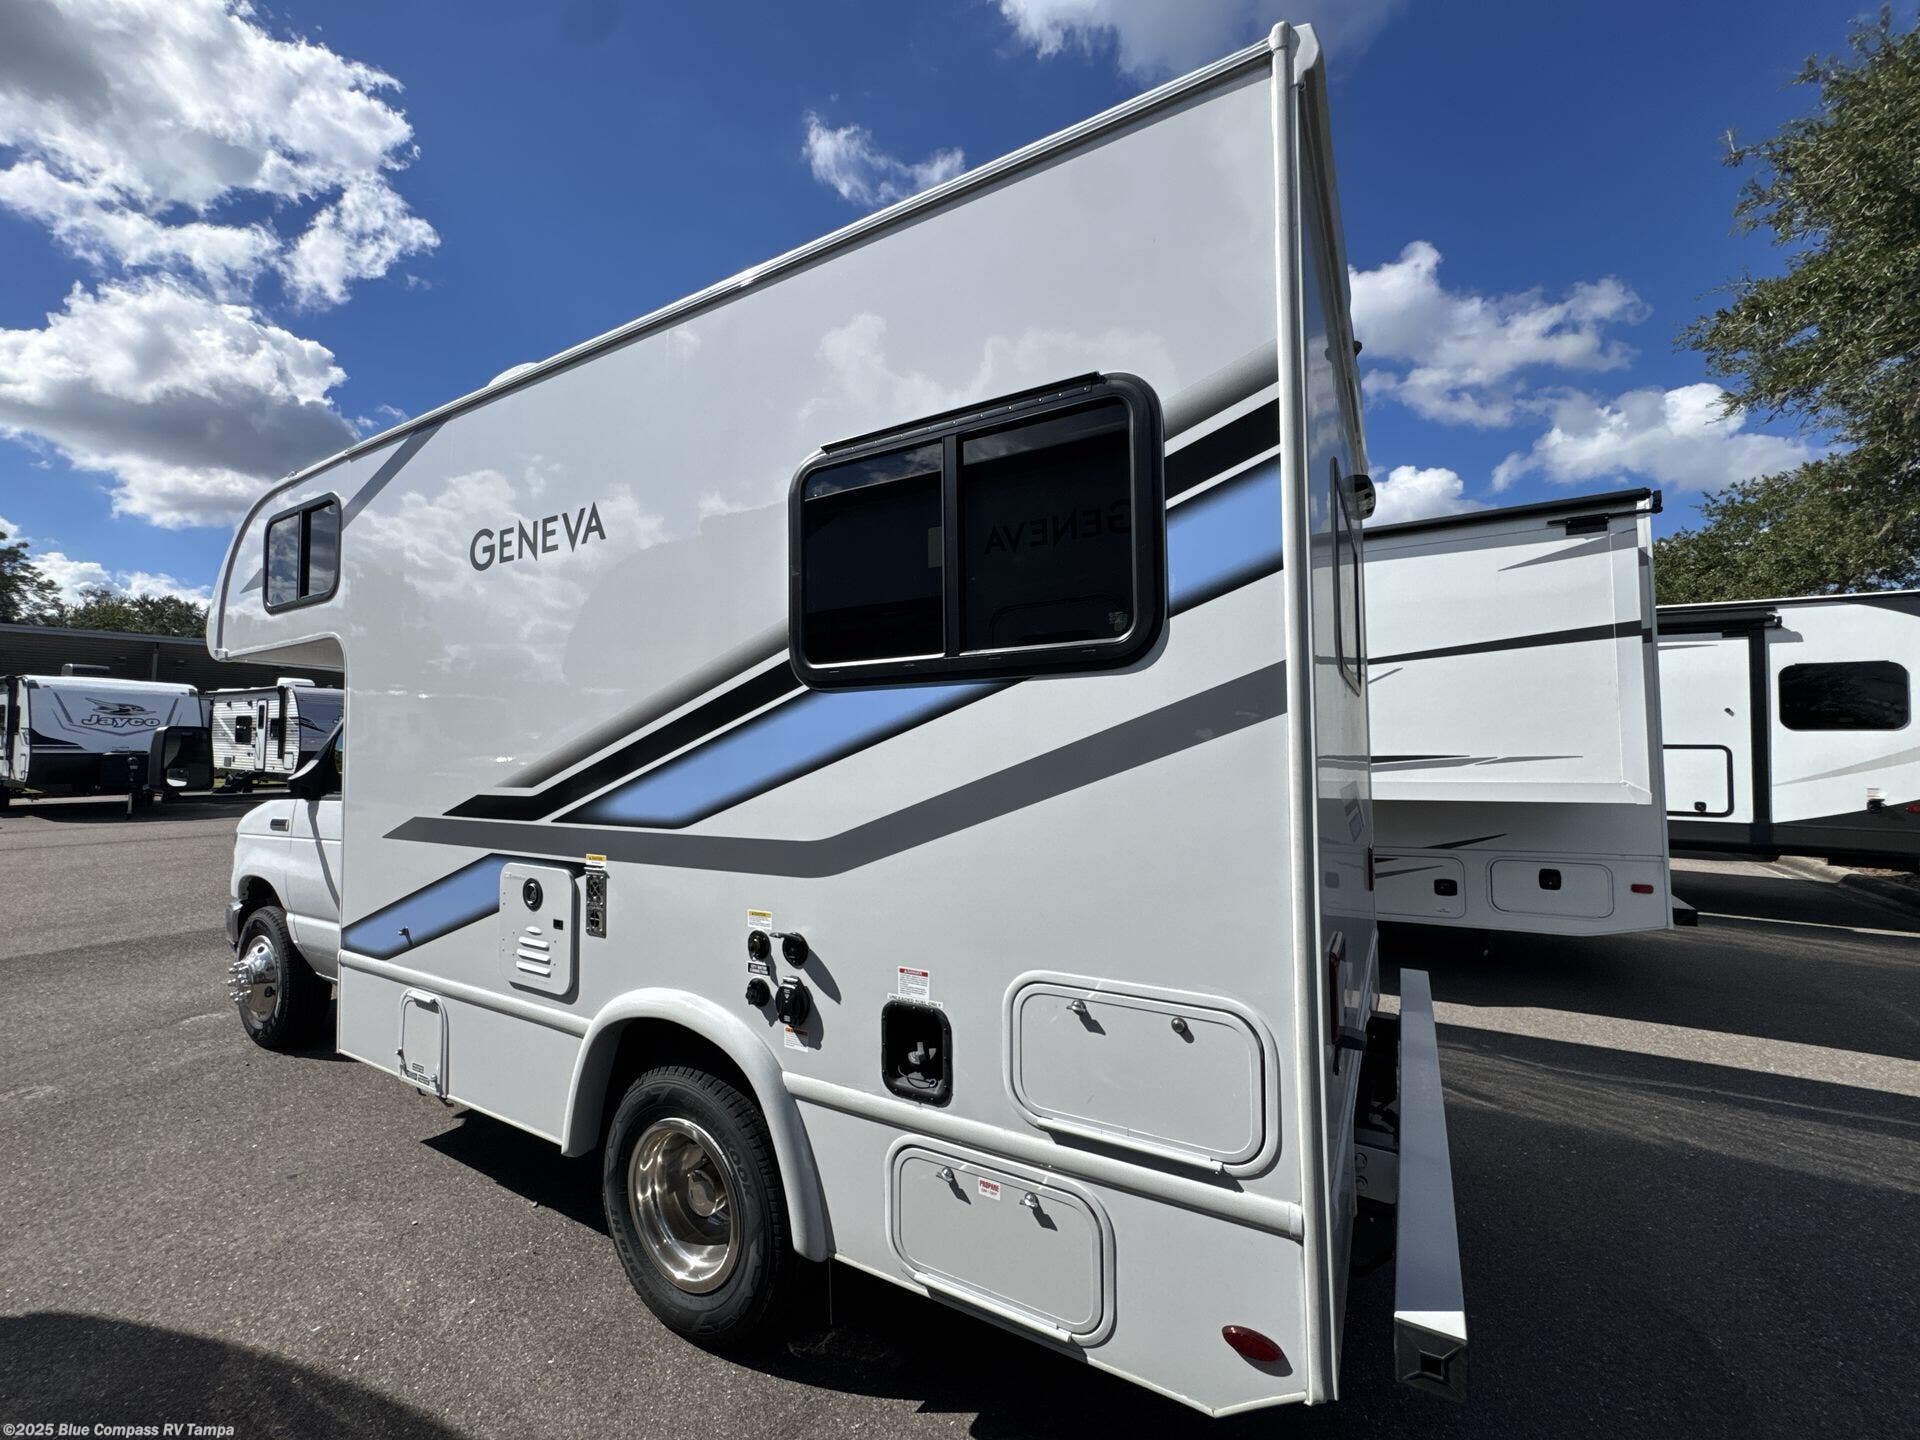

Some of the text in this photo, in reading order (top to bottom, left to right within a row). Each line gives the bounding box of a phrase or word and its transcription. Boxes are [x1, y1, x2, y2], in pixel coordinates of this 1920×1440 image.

[470, 502, 606, 571] GENEVA
[81, 714, 160, 728] Jayco
[979, 1180, 1000, 1193] PROPANE
